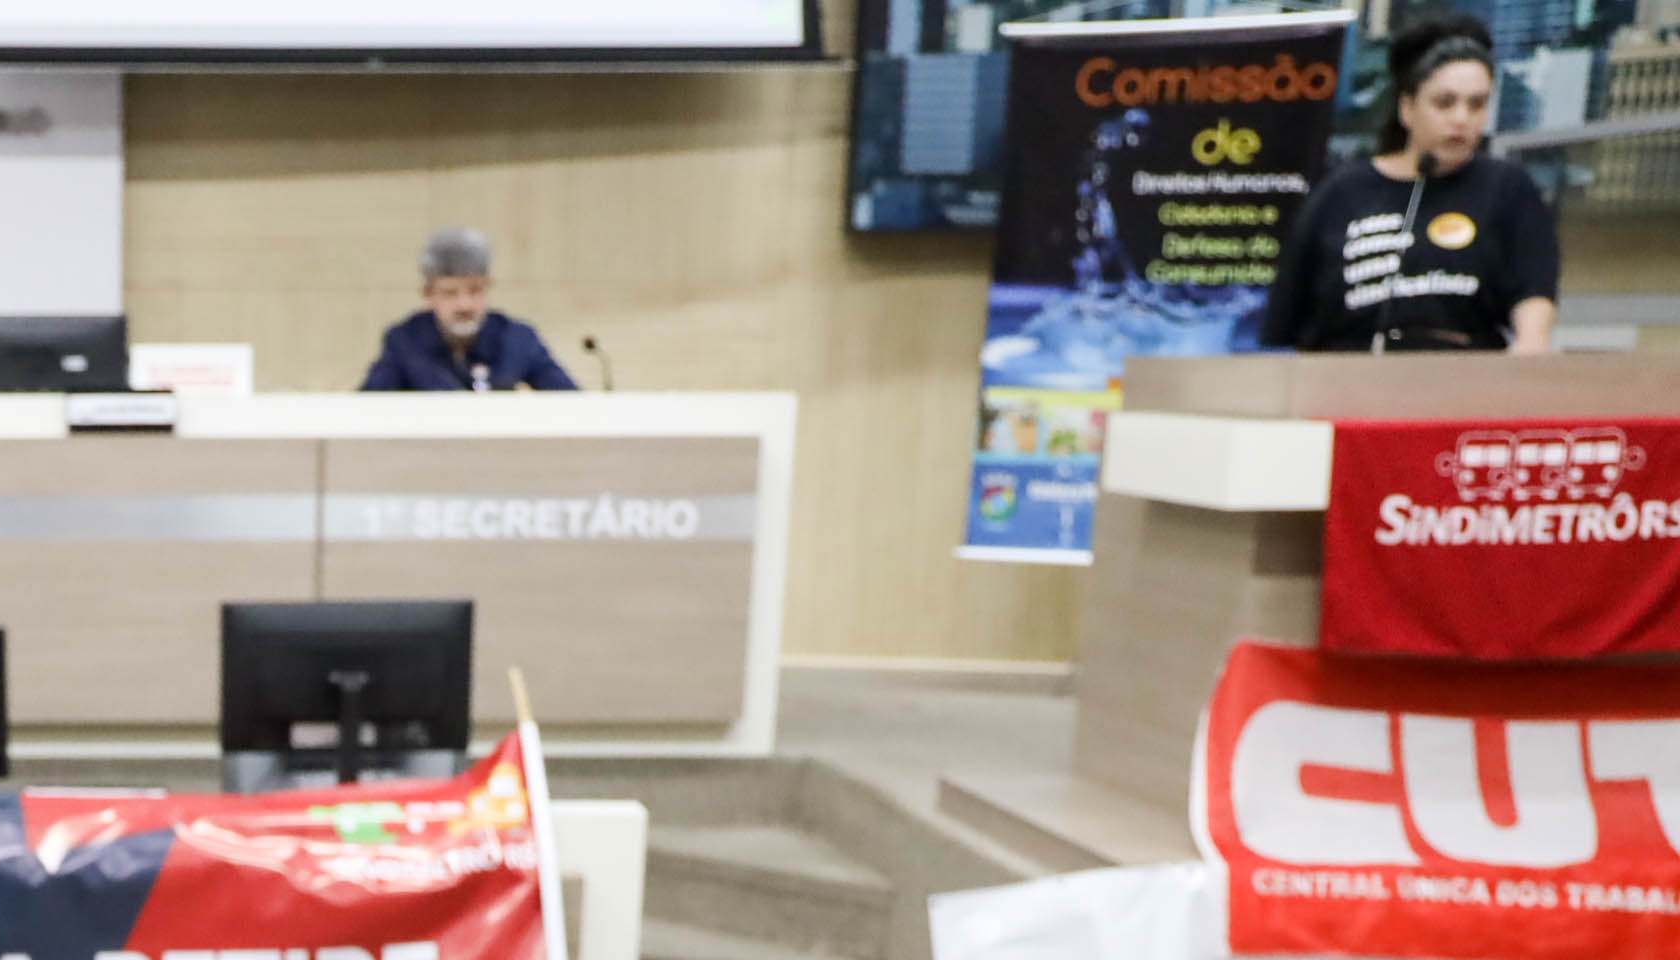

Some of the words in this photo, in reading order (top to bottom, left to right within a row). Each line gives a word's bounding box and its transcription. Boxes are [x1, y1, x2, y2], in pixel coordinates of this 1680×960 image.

[1075, 53, 1337, 107] Comissão
[1191, 118, 1261, 165] de
[414, 492, 699, 538] SECRETÁRIO
[1252, 868, 1390, 899] CENTRAL
[1495, 880, 1557, 908] DOS
